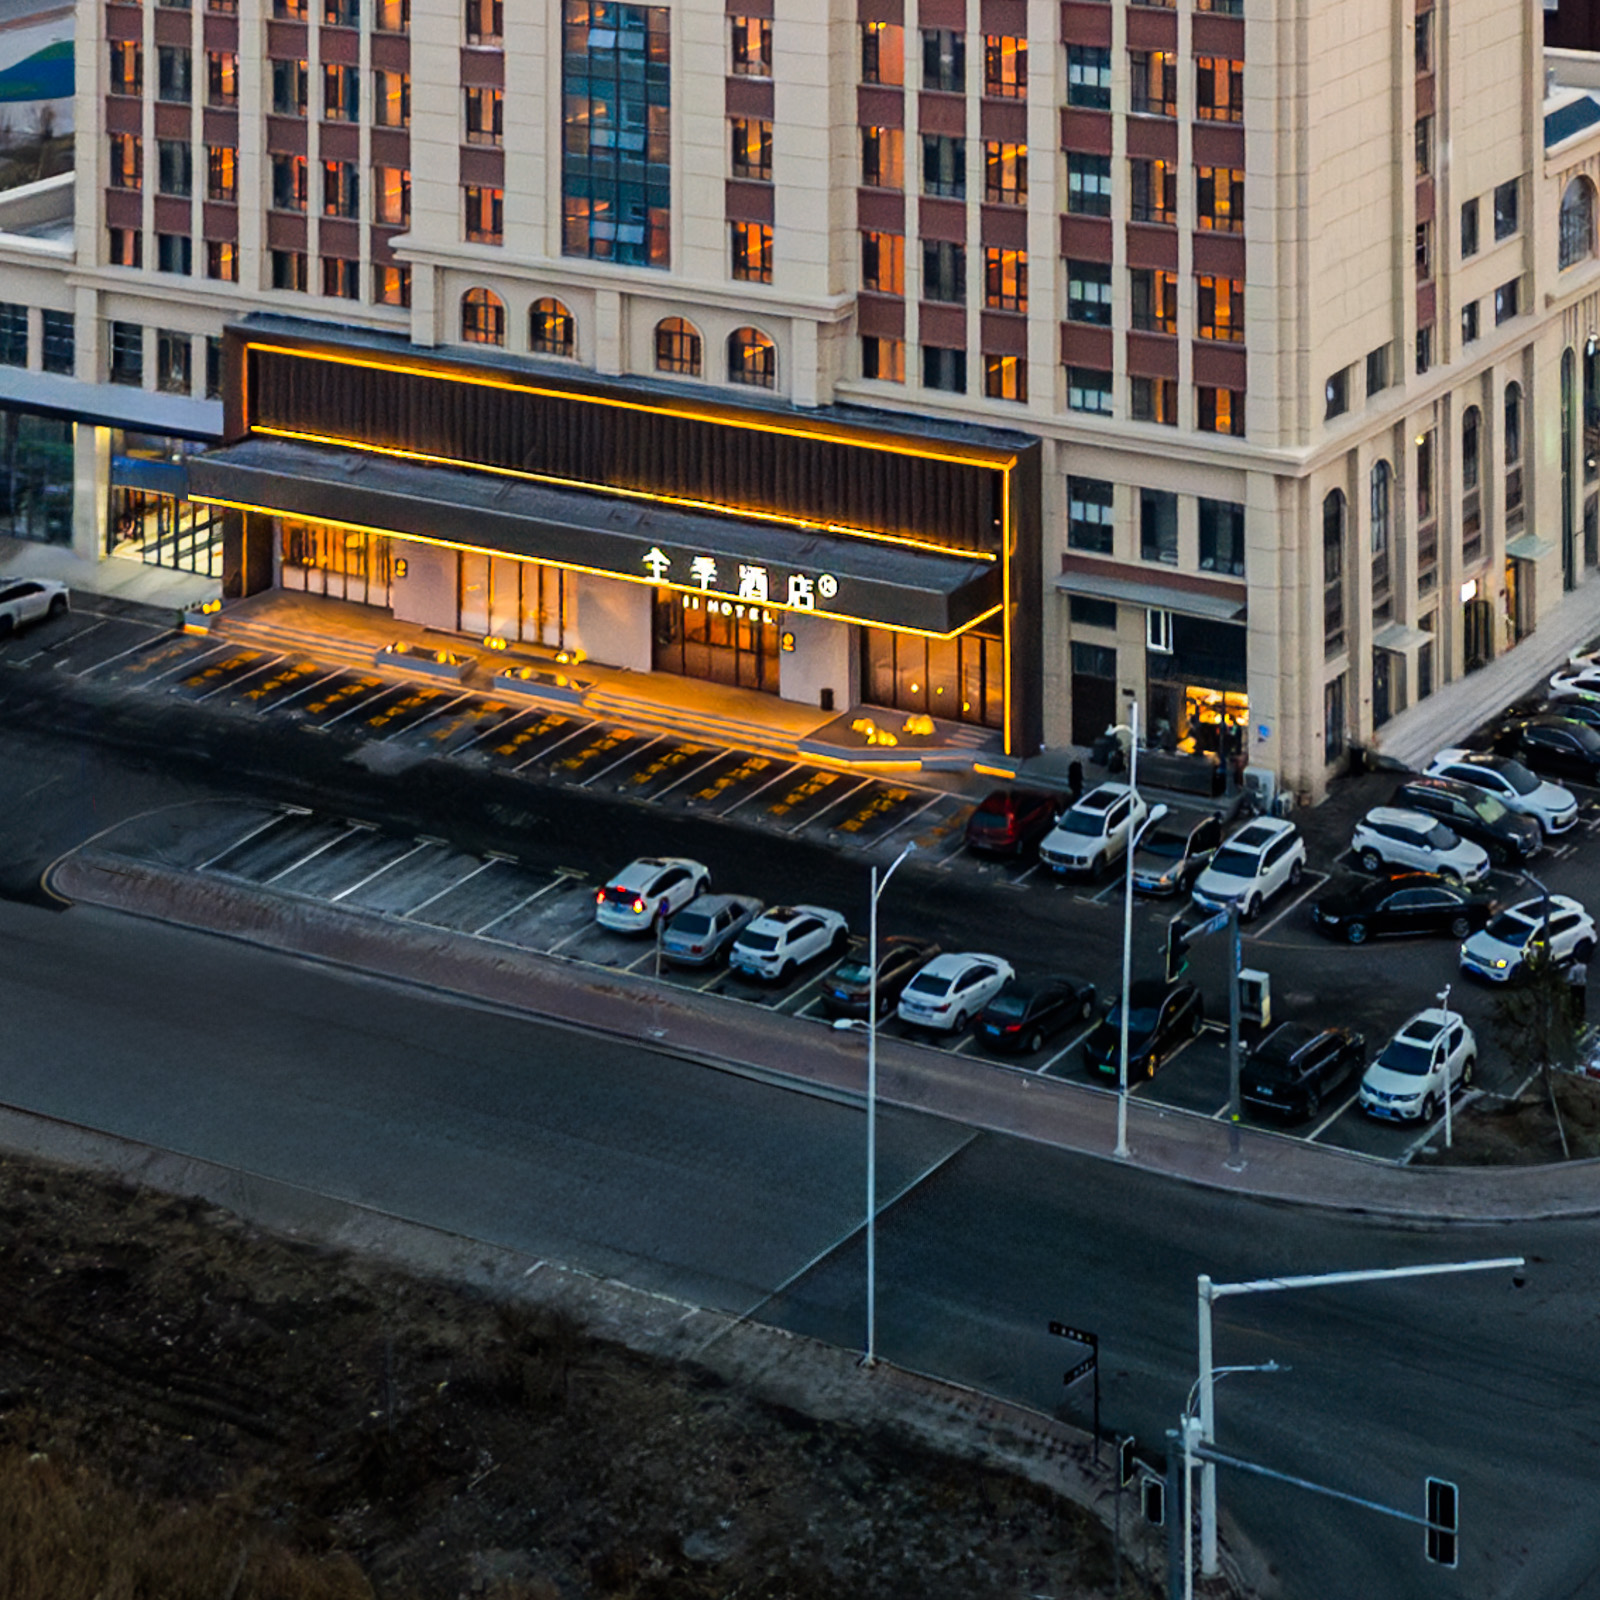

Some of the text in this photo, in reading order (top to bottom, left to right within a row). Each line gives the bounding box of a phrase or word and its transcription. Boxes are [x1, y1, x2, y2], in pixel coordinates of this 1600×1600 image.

[641, 547, 816, 611] 全季酒店
[707, 600, 773, 624] HOTEL
